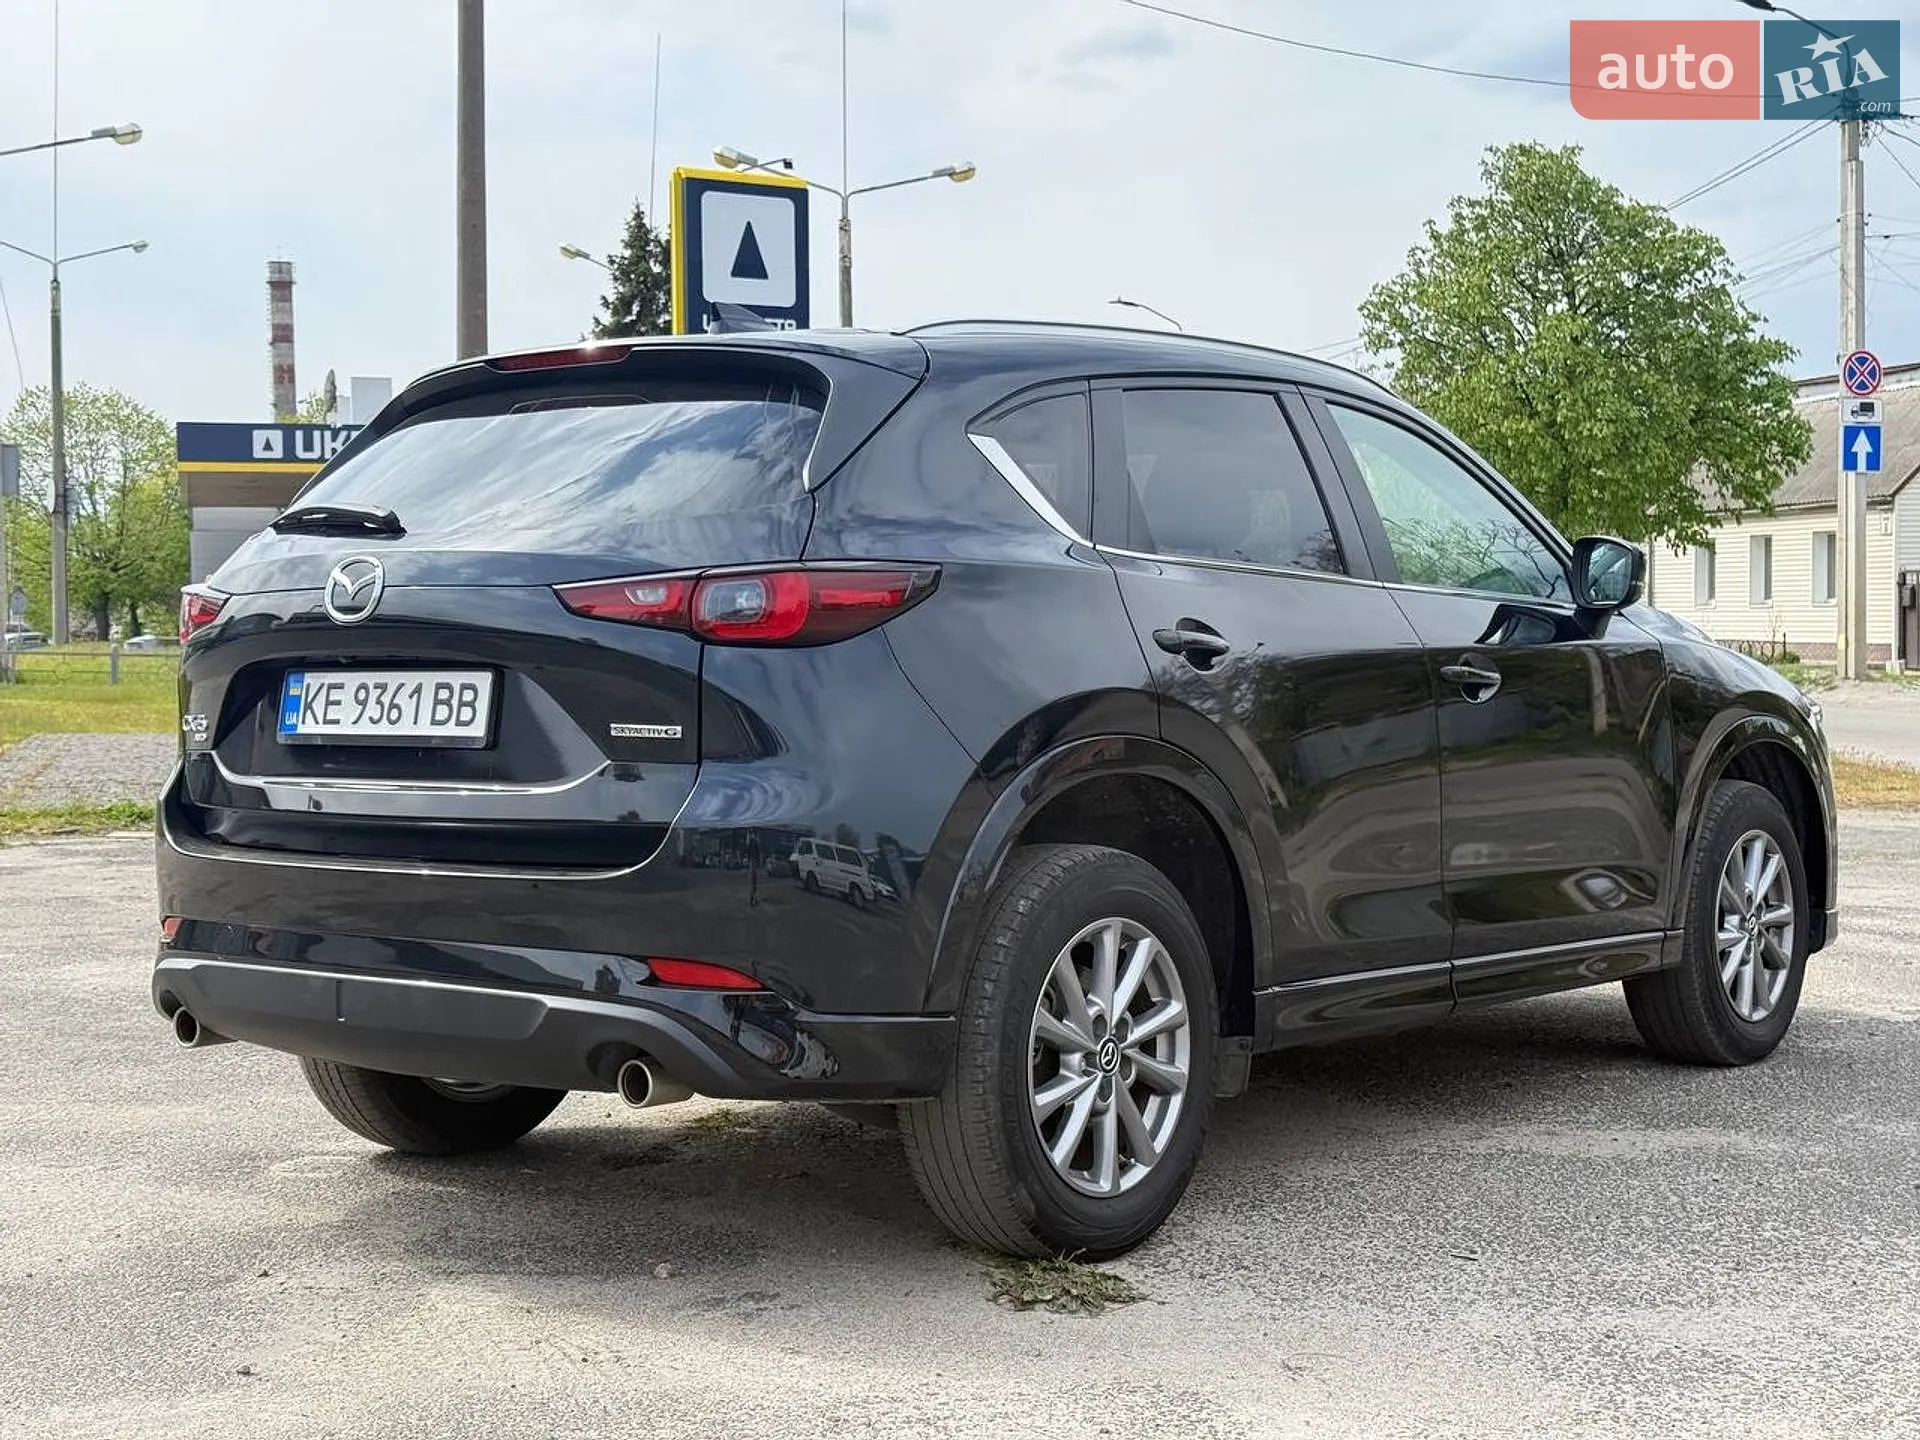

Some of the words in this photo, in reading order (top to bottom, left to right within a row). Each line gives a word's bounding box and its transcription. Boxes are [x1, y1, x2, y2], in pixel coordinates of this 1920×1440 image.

[295, 430, 360, 459] UK
[302, 682, 344, 725] KE
[351, 682, 423, 725] 9361
[430, 682, 478, 727] BB
